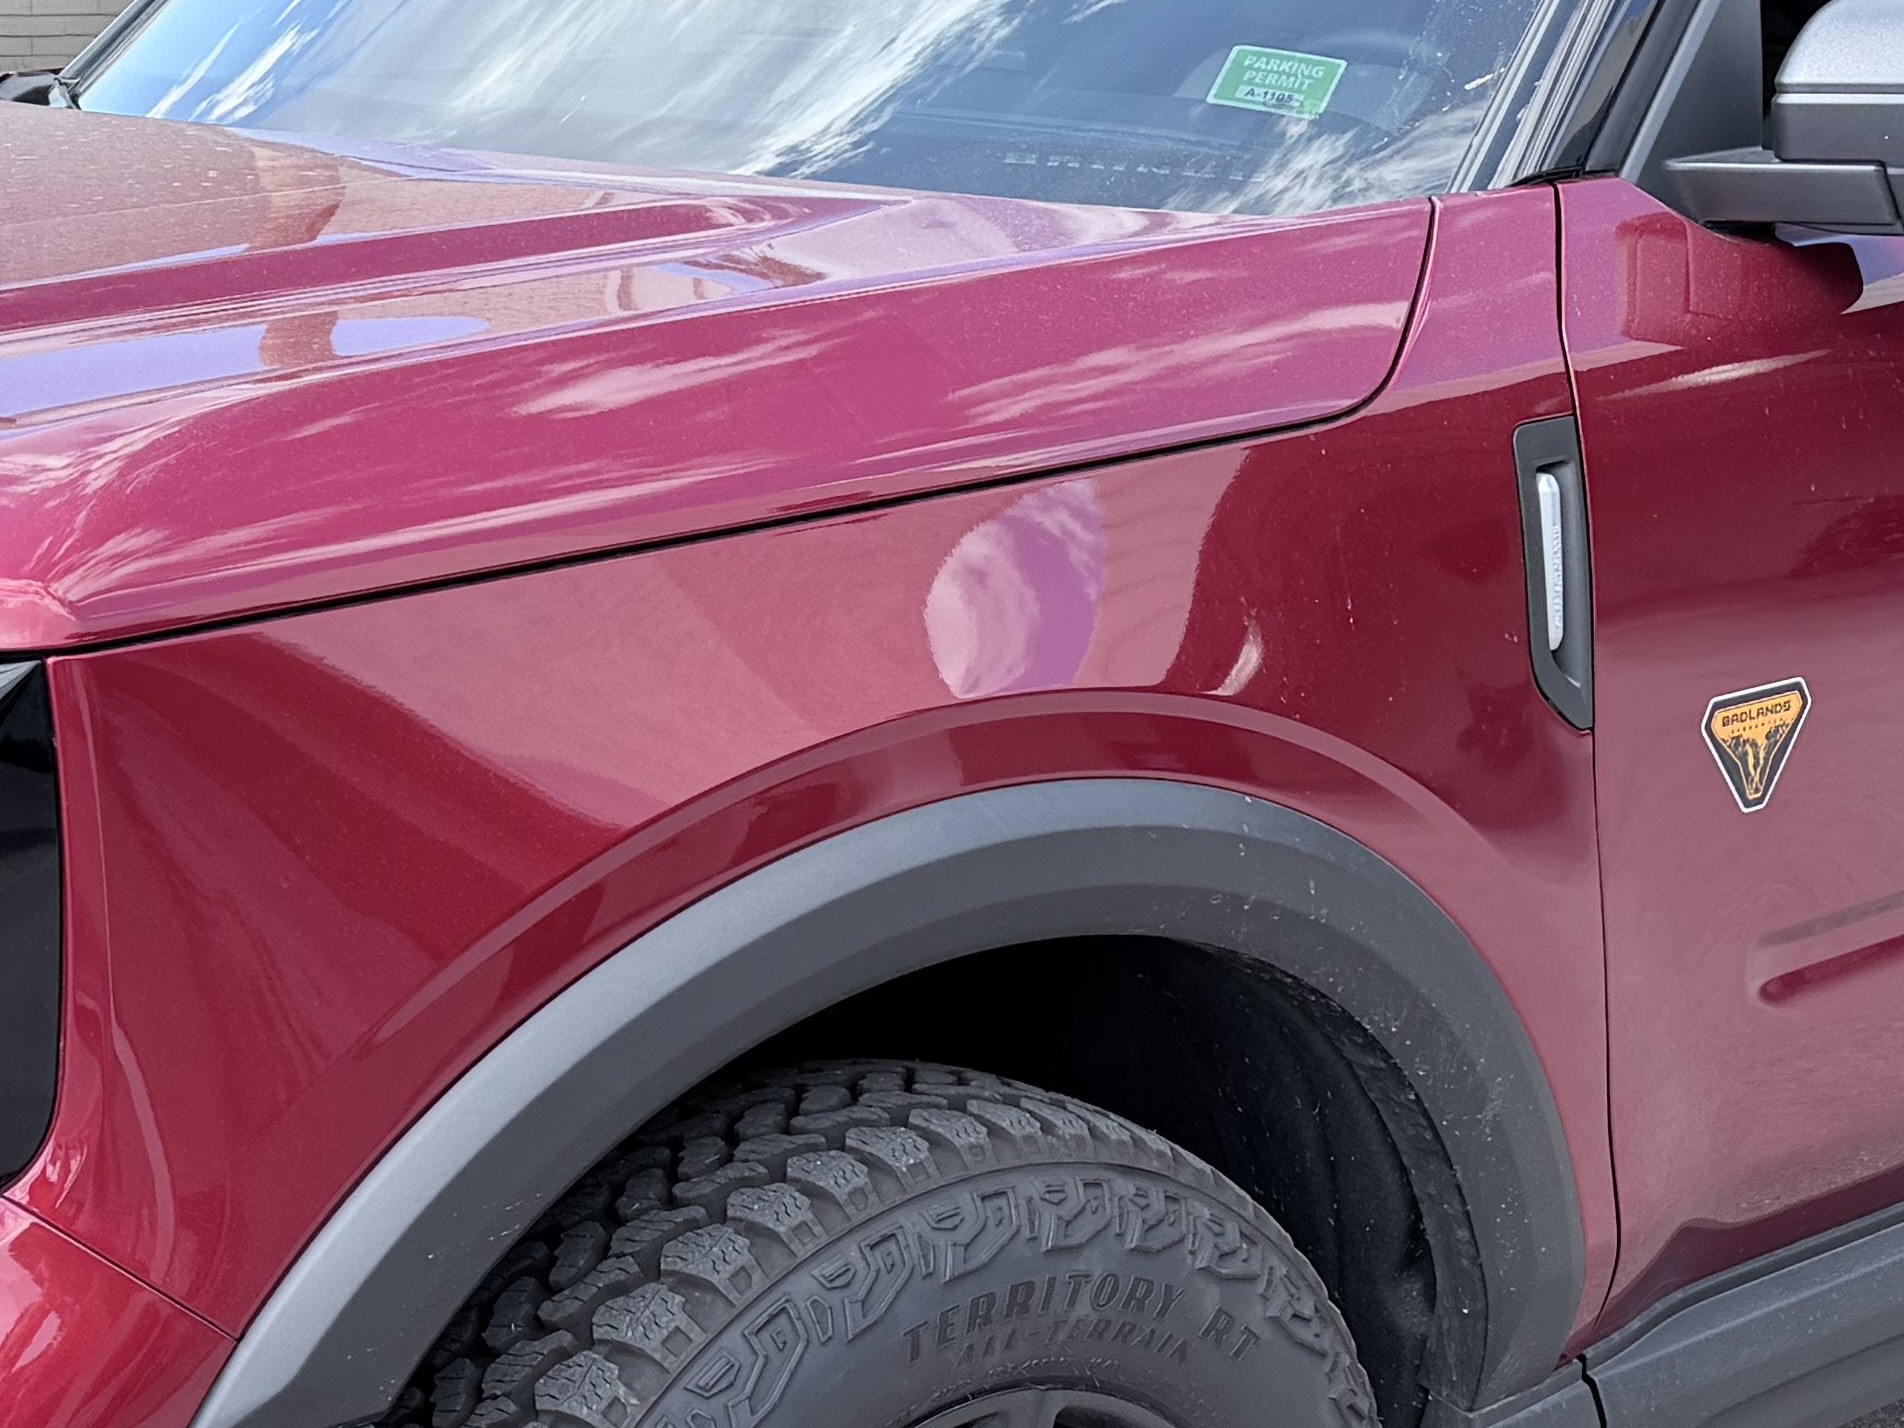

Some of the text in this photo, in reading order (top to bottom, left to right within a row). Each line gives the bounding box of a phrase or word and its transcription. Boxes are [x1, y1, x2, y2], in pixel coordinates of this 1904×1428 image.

[1243, 54, 1326, 79] PARKING
[1242, 70, 1315, 91] PERMIT
[1721, 699, 1792, 728] BADLANDS
[899, 1270, 1262, 1365] TERRITORY RT
